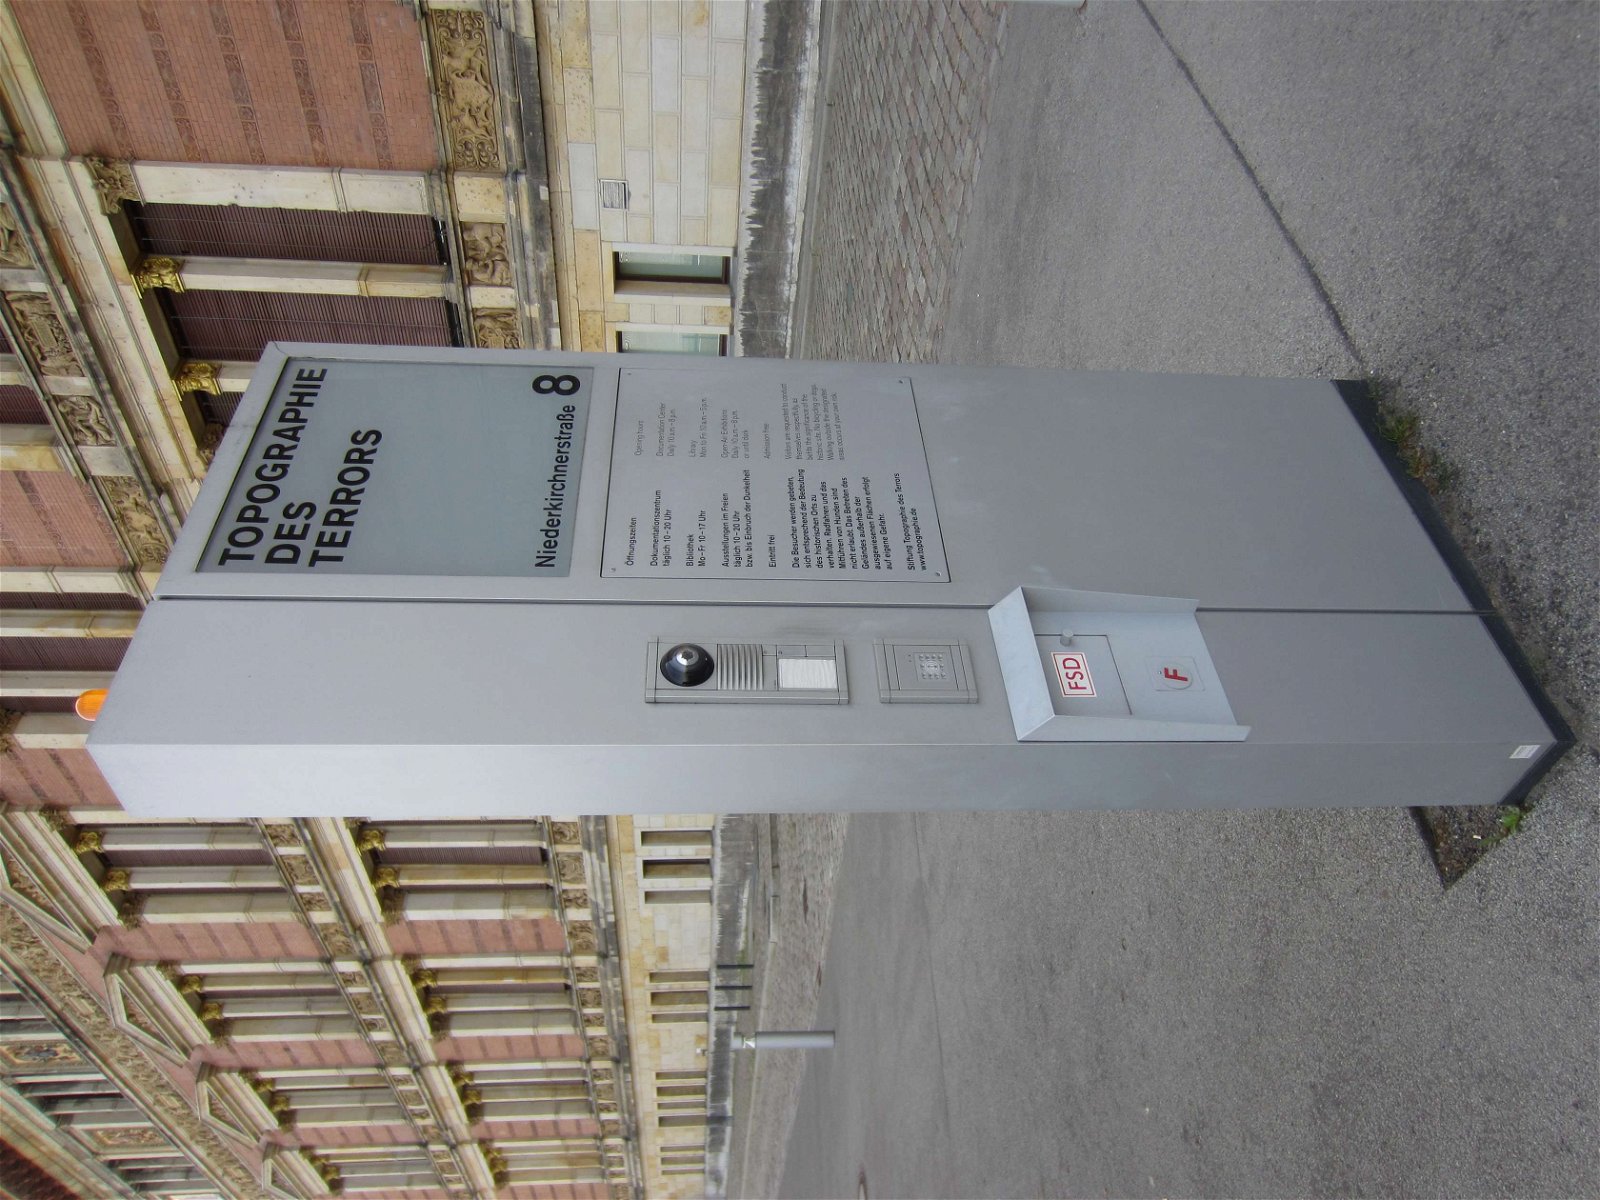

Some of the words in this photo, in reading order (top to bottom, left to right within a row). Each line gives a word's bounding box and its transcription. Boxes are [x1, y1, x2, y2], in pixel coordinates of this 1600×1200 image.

[532, 374, 580, 396] 8
[218, 368, 327, 566] TOPOGRAPHIE
[308, 430, 382, 567] TERRORS
[535, 405, 575, 567] Niederkirchnerstraße
[862, 477, 871, 495] erfolgt
[842, 490, 851, 514] Betreten
[864, 497, 874, 520] Flächen
[264, 502, 317, 564] DES
[650, 490, 661, 566] Dokumentationszentrum
[744, 513, 752, 540] Einbruch
[800, 513, 811, 553] entsprechend
[812, 518, 822, 554] historischen
[822, 506, 832, 536] Radfahren
[855, 508, 865, 537] außerhalb
[899, 507, 911, 543] Topographie
[625, 518, 636, 566] Öffnungszeiten
[722, 523, 730, 567] Ausstellungen
[837, 539, 846, 569] Mitführen
[869, 521, 881, 569] ausgewiesenen
[882, 537, 891, 557] eigene
[910, 508, 926, 570] www.topographie.de
[663, 545, 672, 566] täglich
[734, 546, 742, 567] täglich
[860, 540, 869, 569] Geländes
[905, 546, 915, 570] Stiftung
[1062, 657, 1087, 690] FSD
[1164, 668, 1188, 681] F
